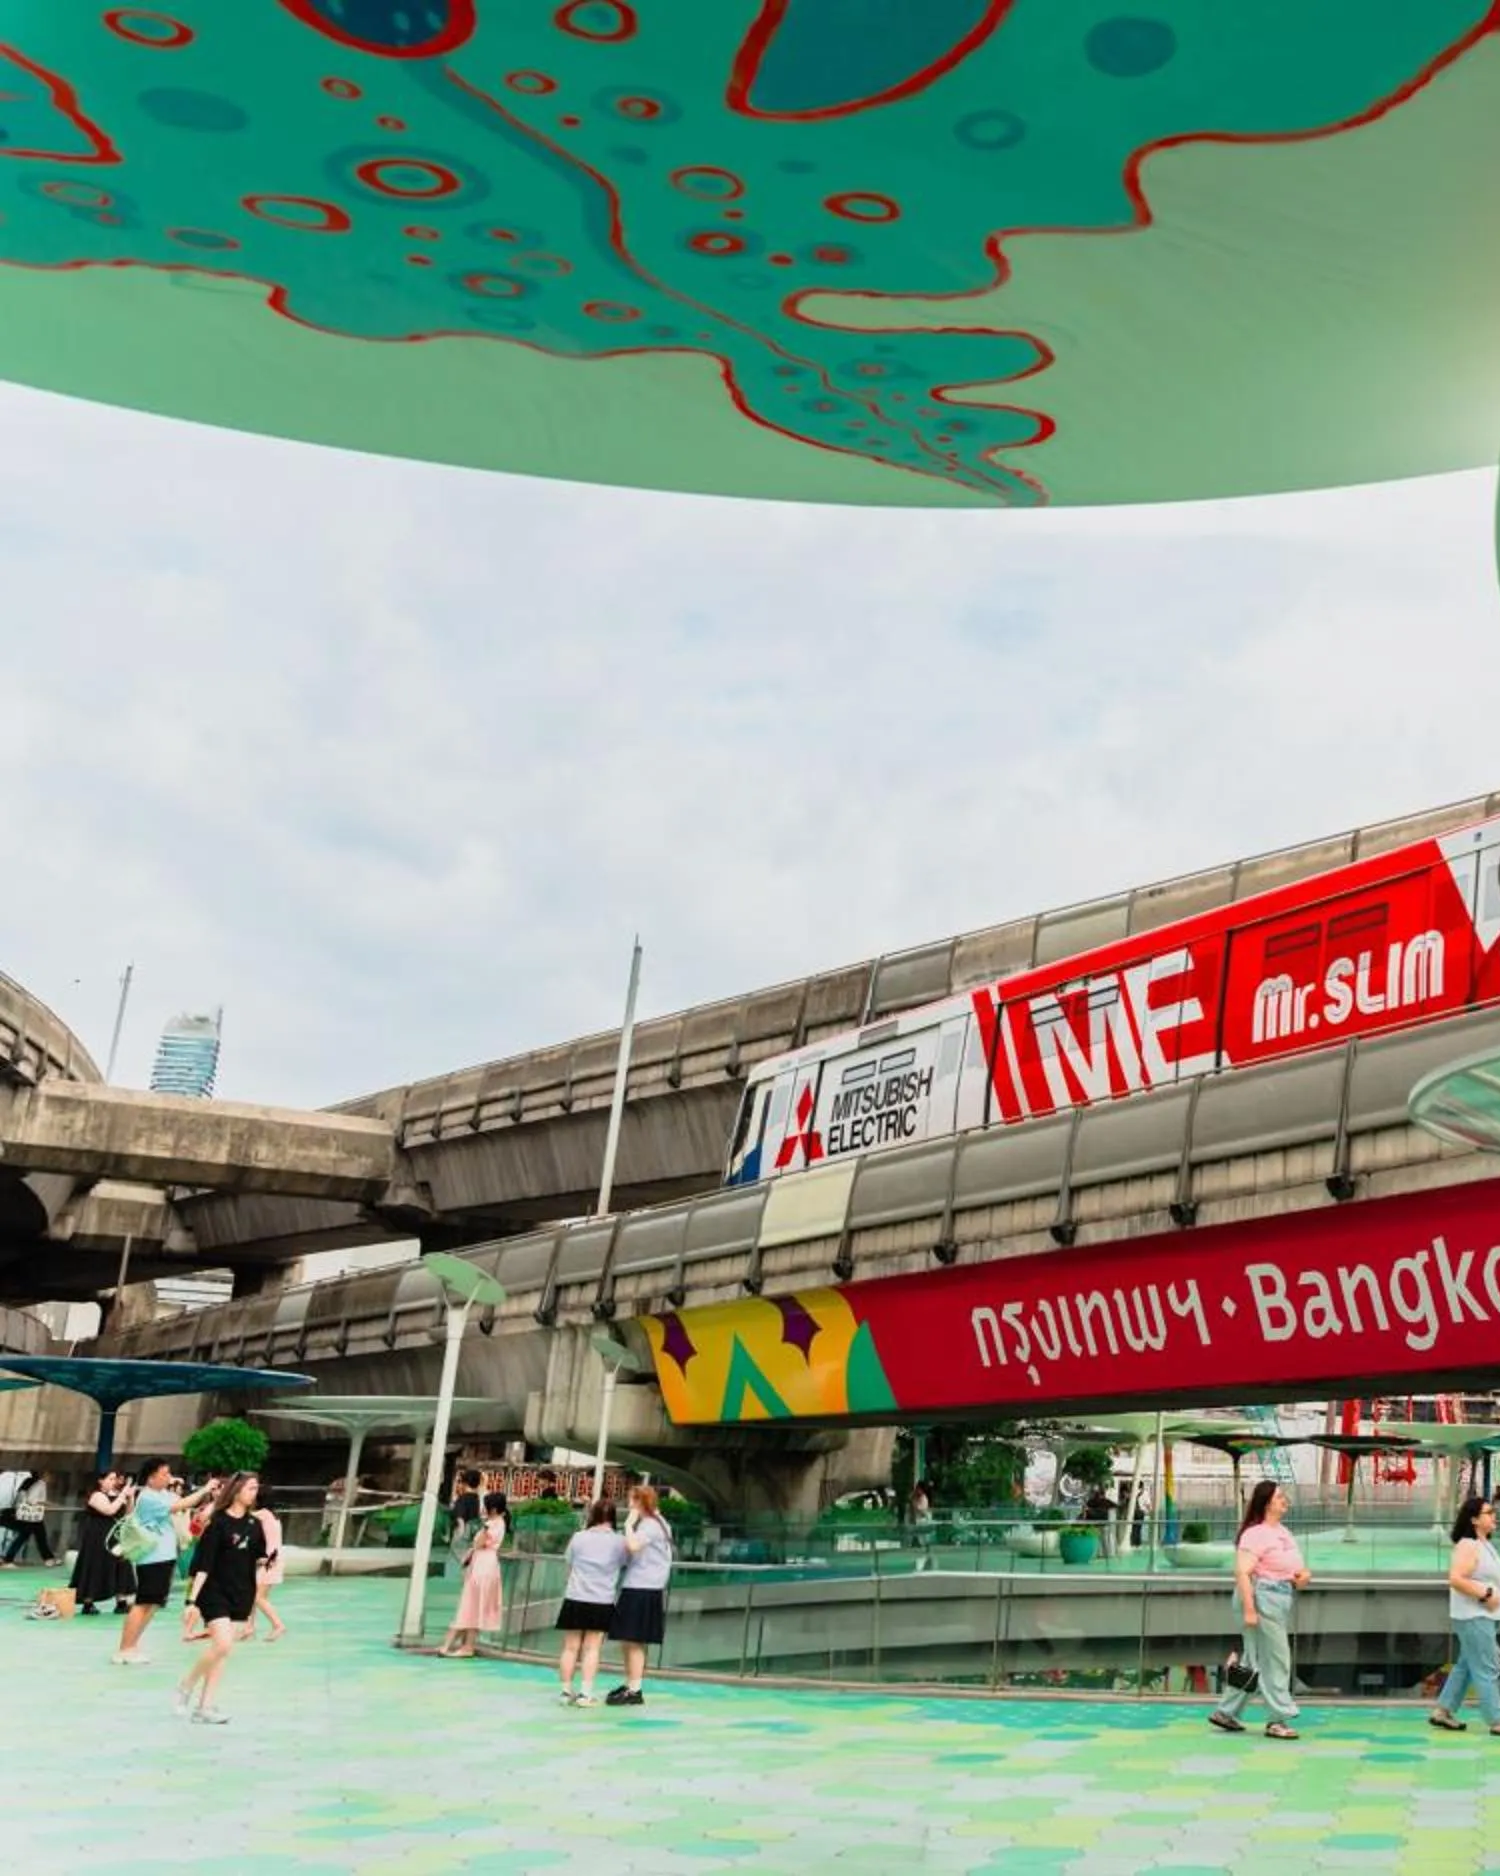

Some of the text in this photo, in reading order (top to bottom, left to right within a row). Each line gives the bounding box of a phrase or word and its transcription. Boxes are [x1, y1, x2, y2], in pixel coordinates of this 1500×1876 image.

[827, 1104, 917, 1156] ELECTRIC
[971, 1279, 1211, 1385] กรุงเทพฯ
